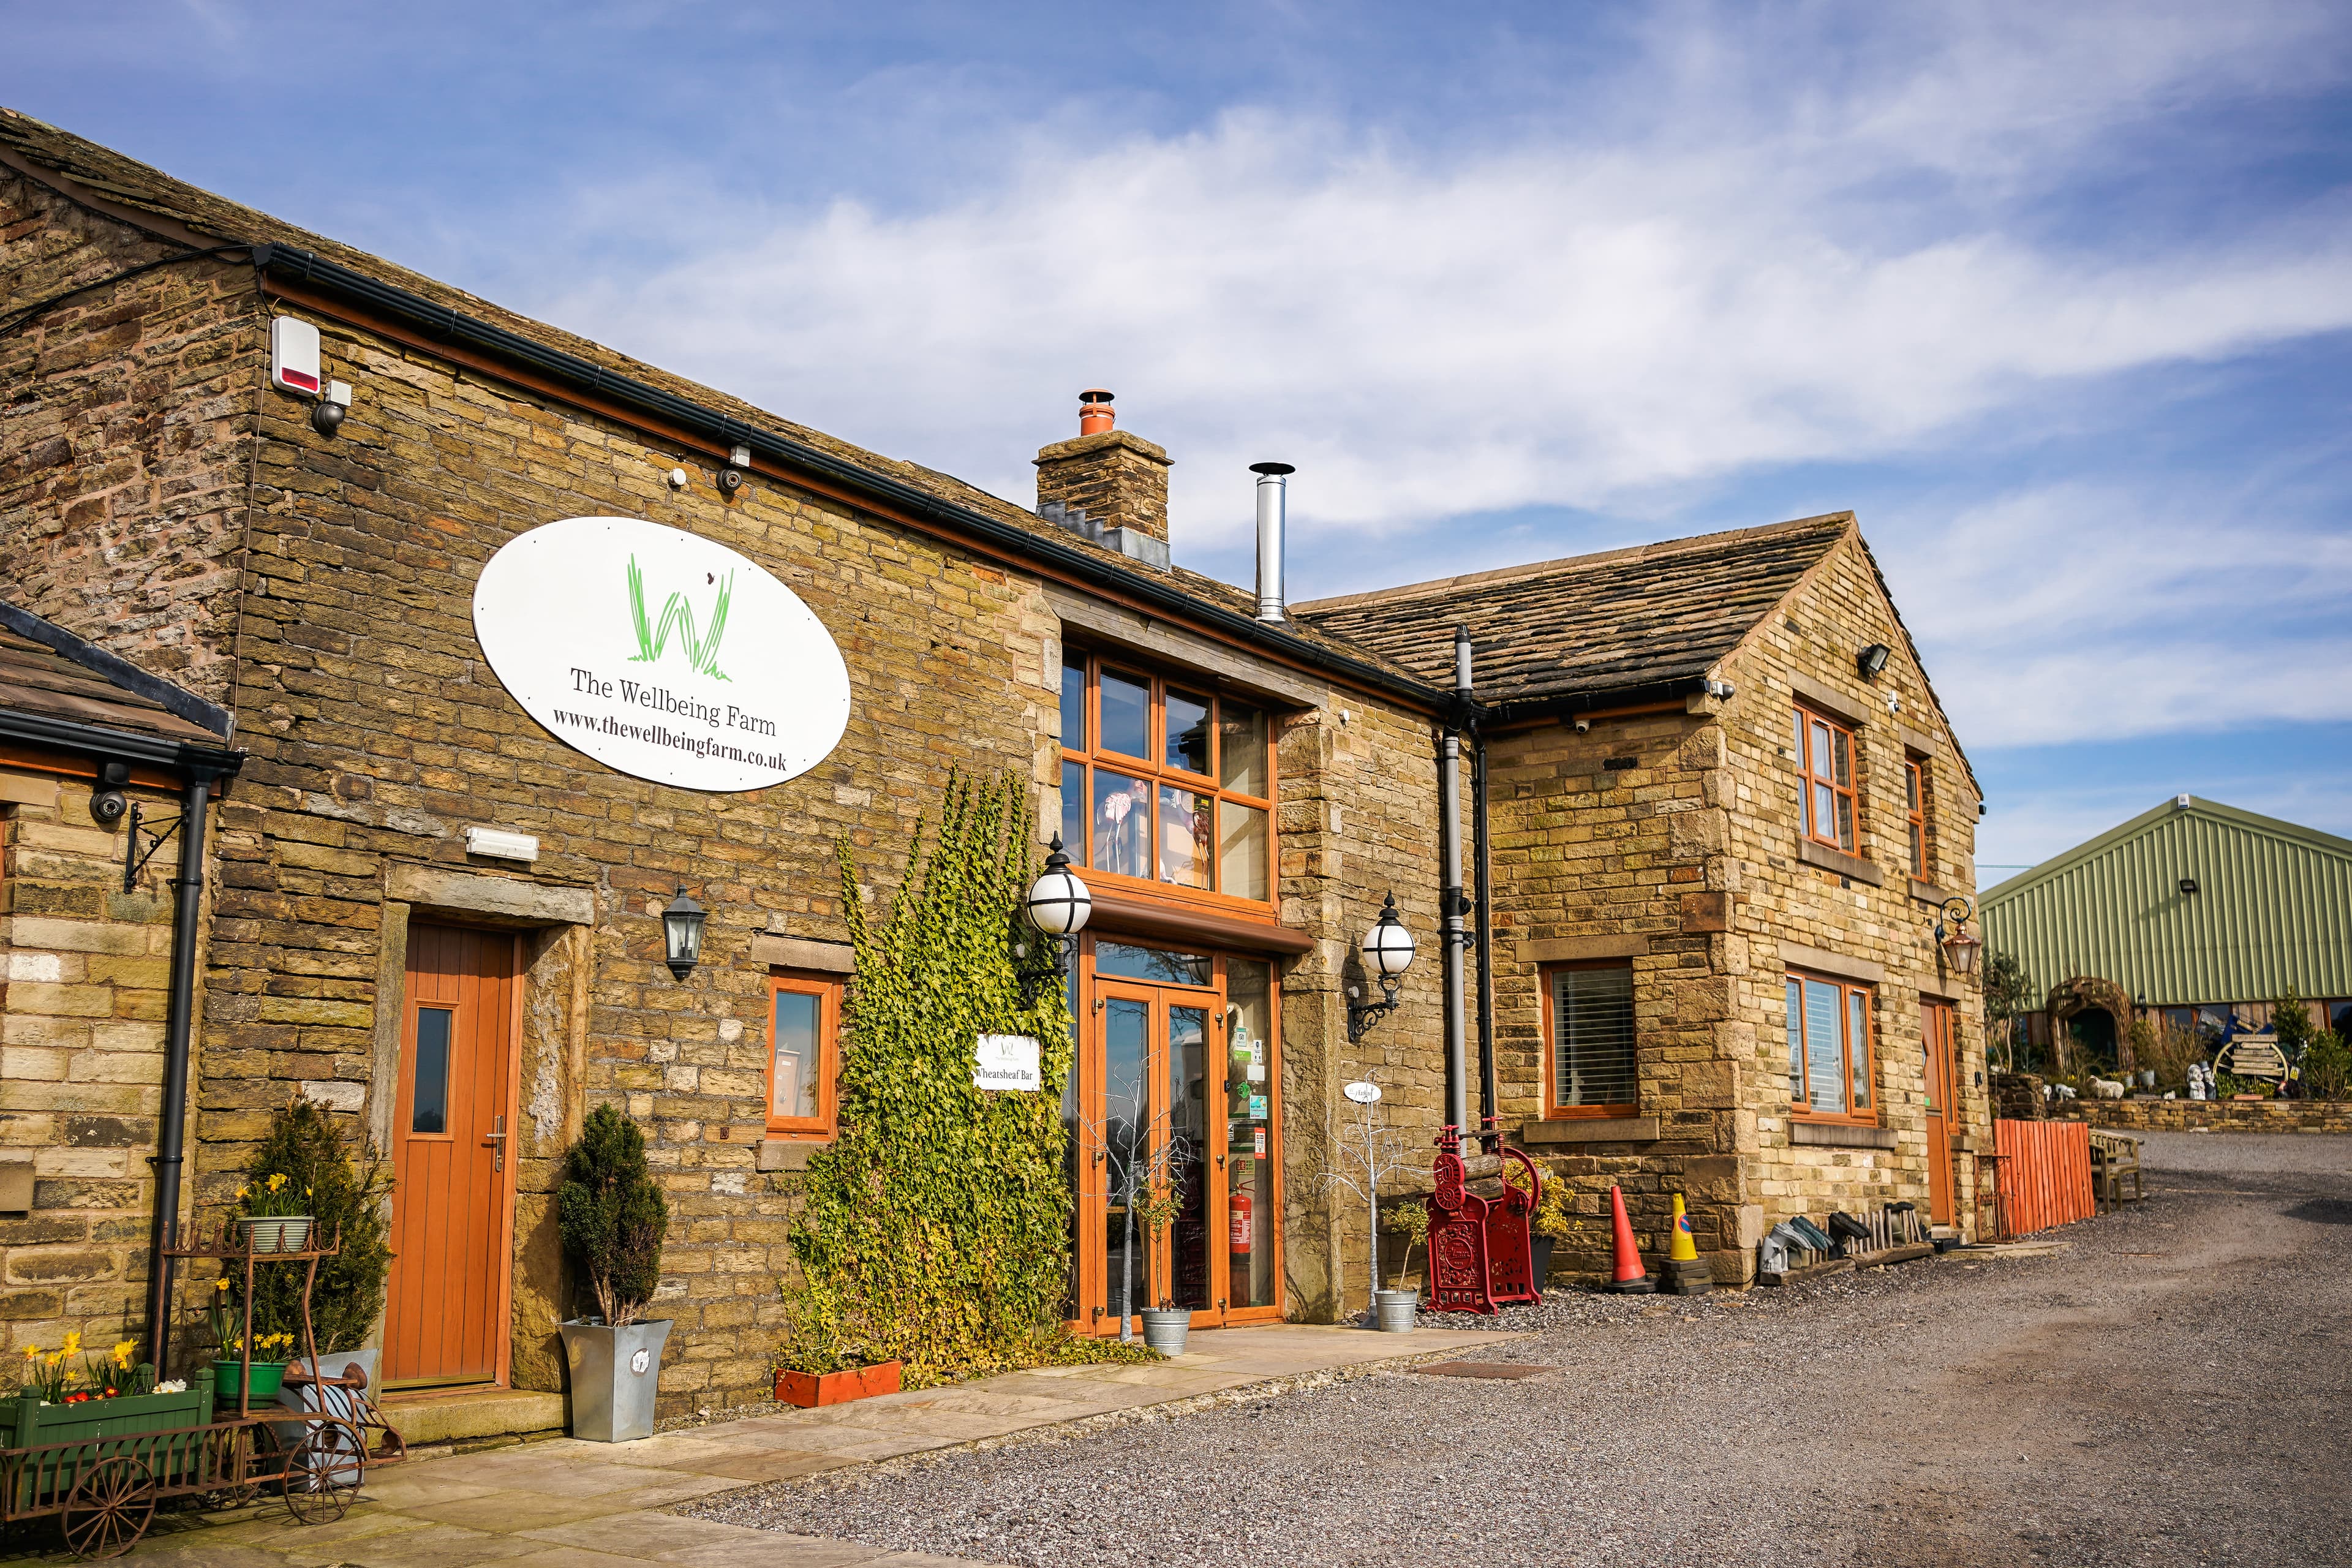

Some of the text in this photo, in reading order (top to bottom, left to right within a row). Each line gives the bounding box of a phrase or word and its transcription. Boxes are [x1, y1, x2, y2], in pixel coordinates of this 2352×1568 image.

[570, 667, 777, 737] The Wellbeing Farm
[552, 709, 787, 772] www.thewellbeingfarm.co.uk
[976, 1068, 1033, 1080] Wheatsheaf Bar
